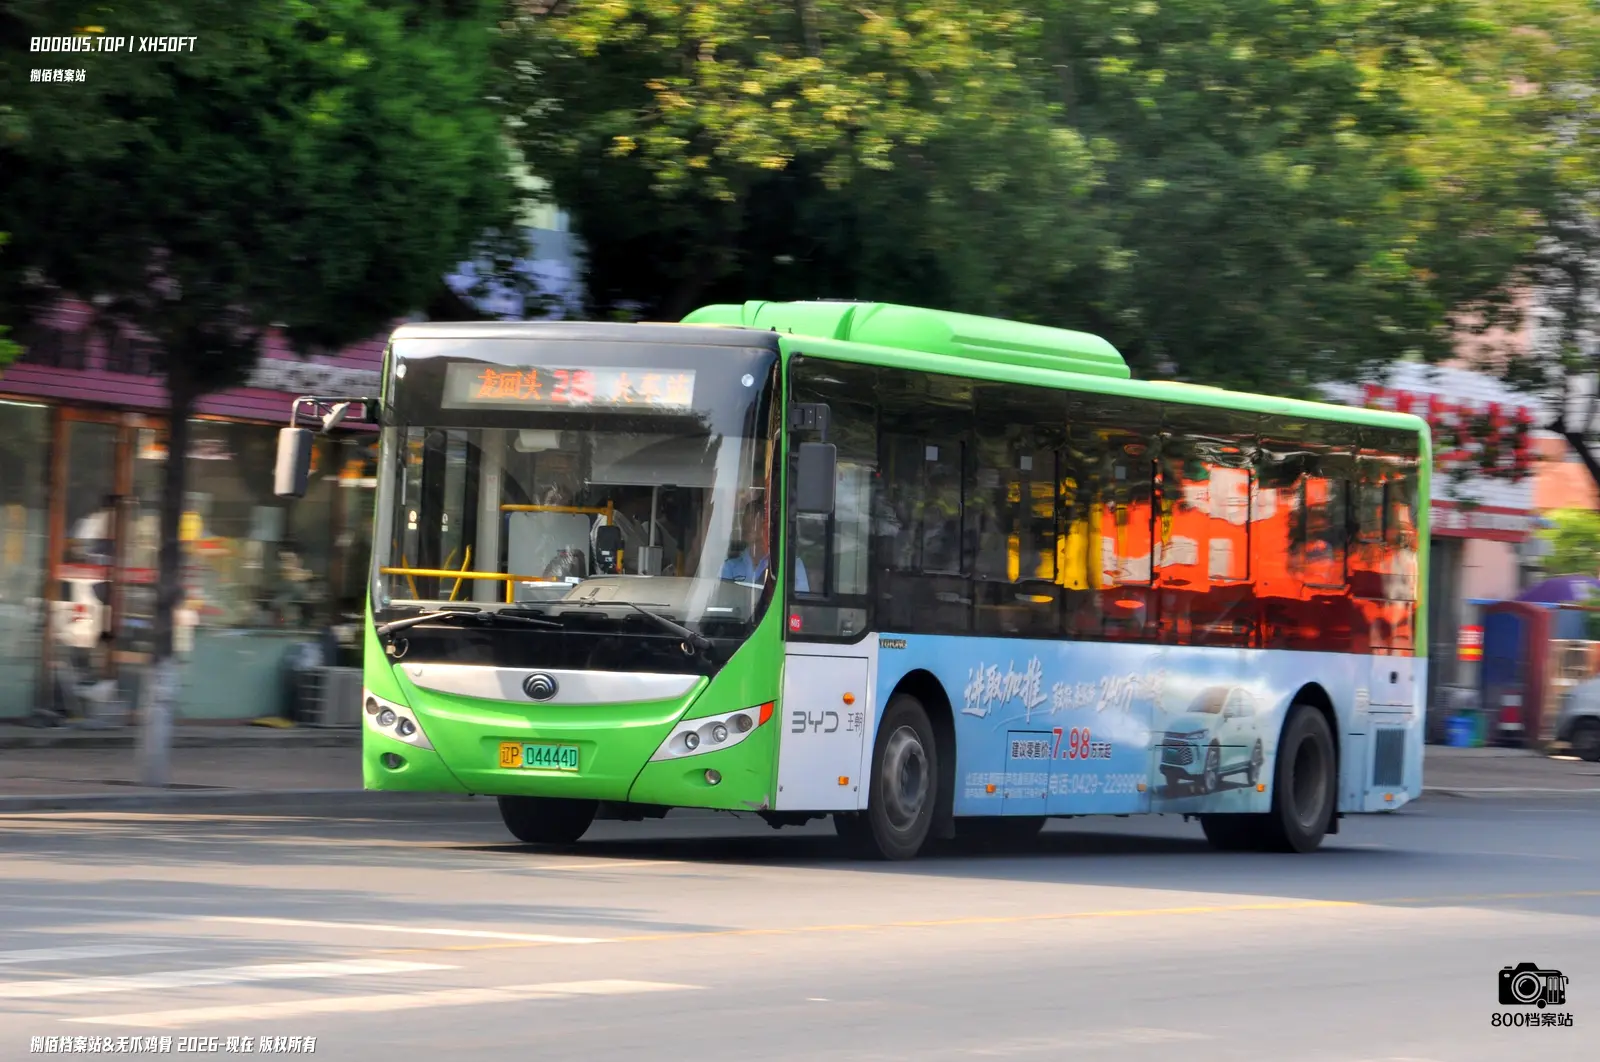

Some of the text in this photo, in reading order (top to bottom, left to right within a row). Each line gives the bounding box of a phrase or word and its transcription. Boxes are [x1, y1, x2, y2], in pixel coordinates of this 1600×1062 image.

[477, 367, 542, 400] 龙回头
[791, 711, 864, 738] BYD 王朝
[526, 747, 577, 767] 04444D
